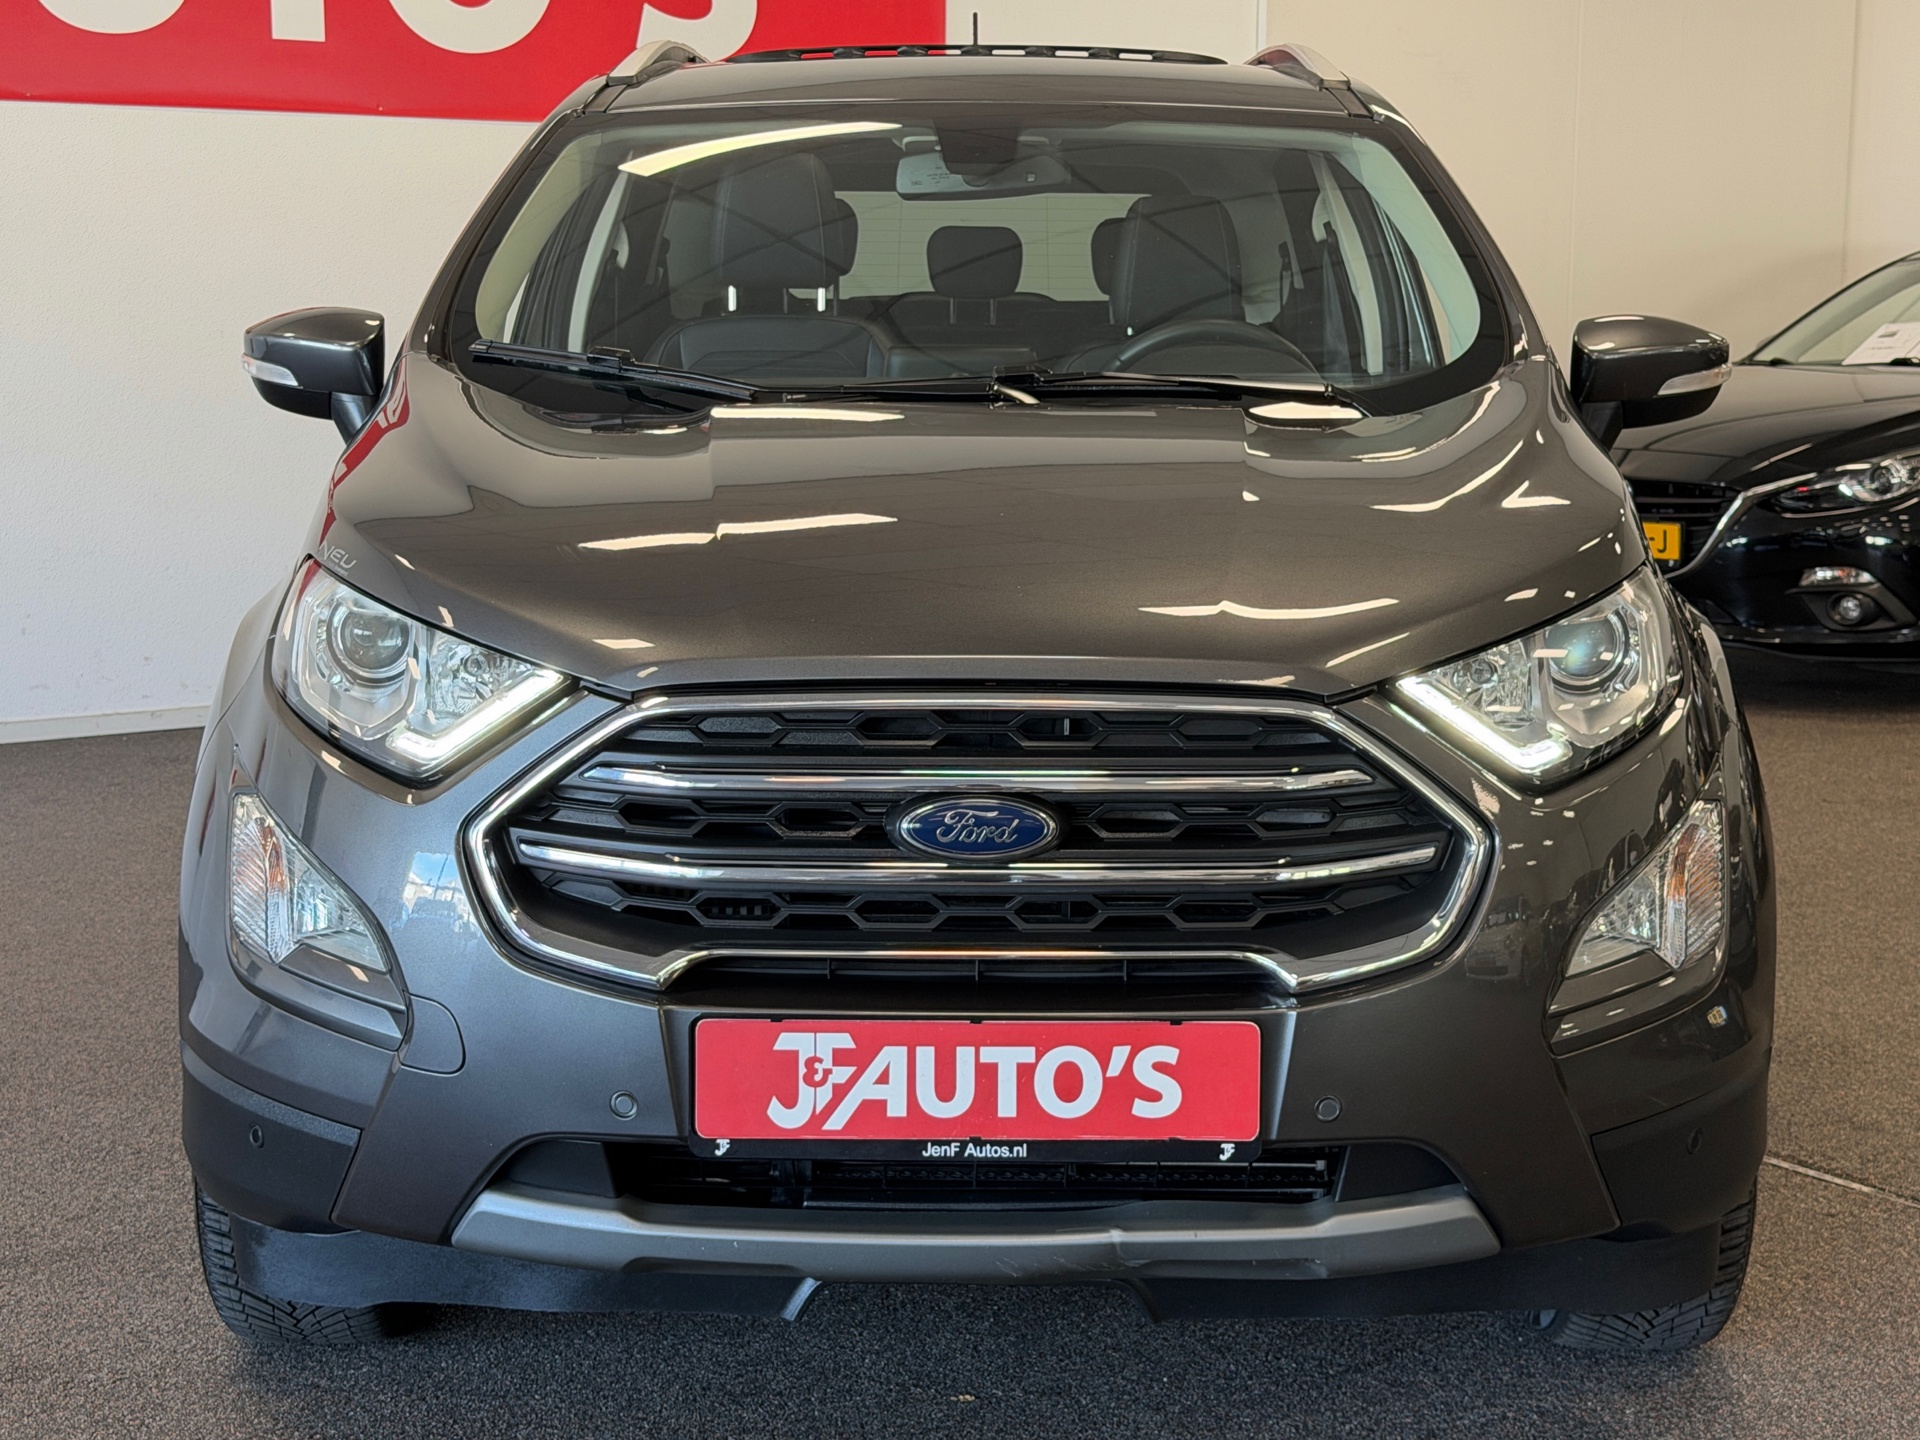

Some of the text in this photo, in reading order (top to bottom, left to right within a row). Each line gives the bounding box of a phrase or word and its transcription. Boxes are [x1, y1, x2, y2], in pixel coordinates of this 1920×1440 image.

[935, 808, 1020, 844] Ford
[922, 1142, 1027, 1158] JenF Autos.nl
